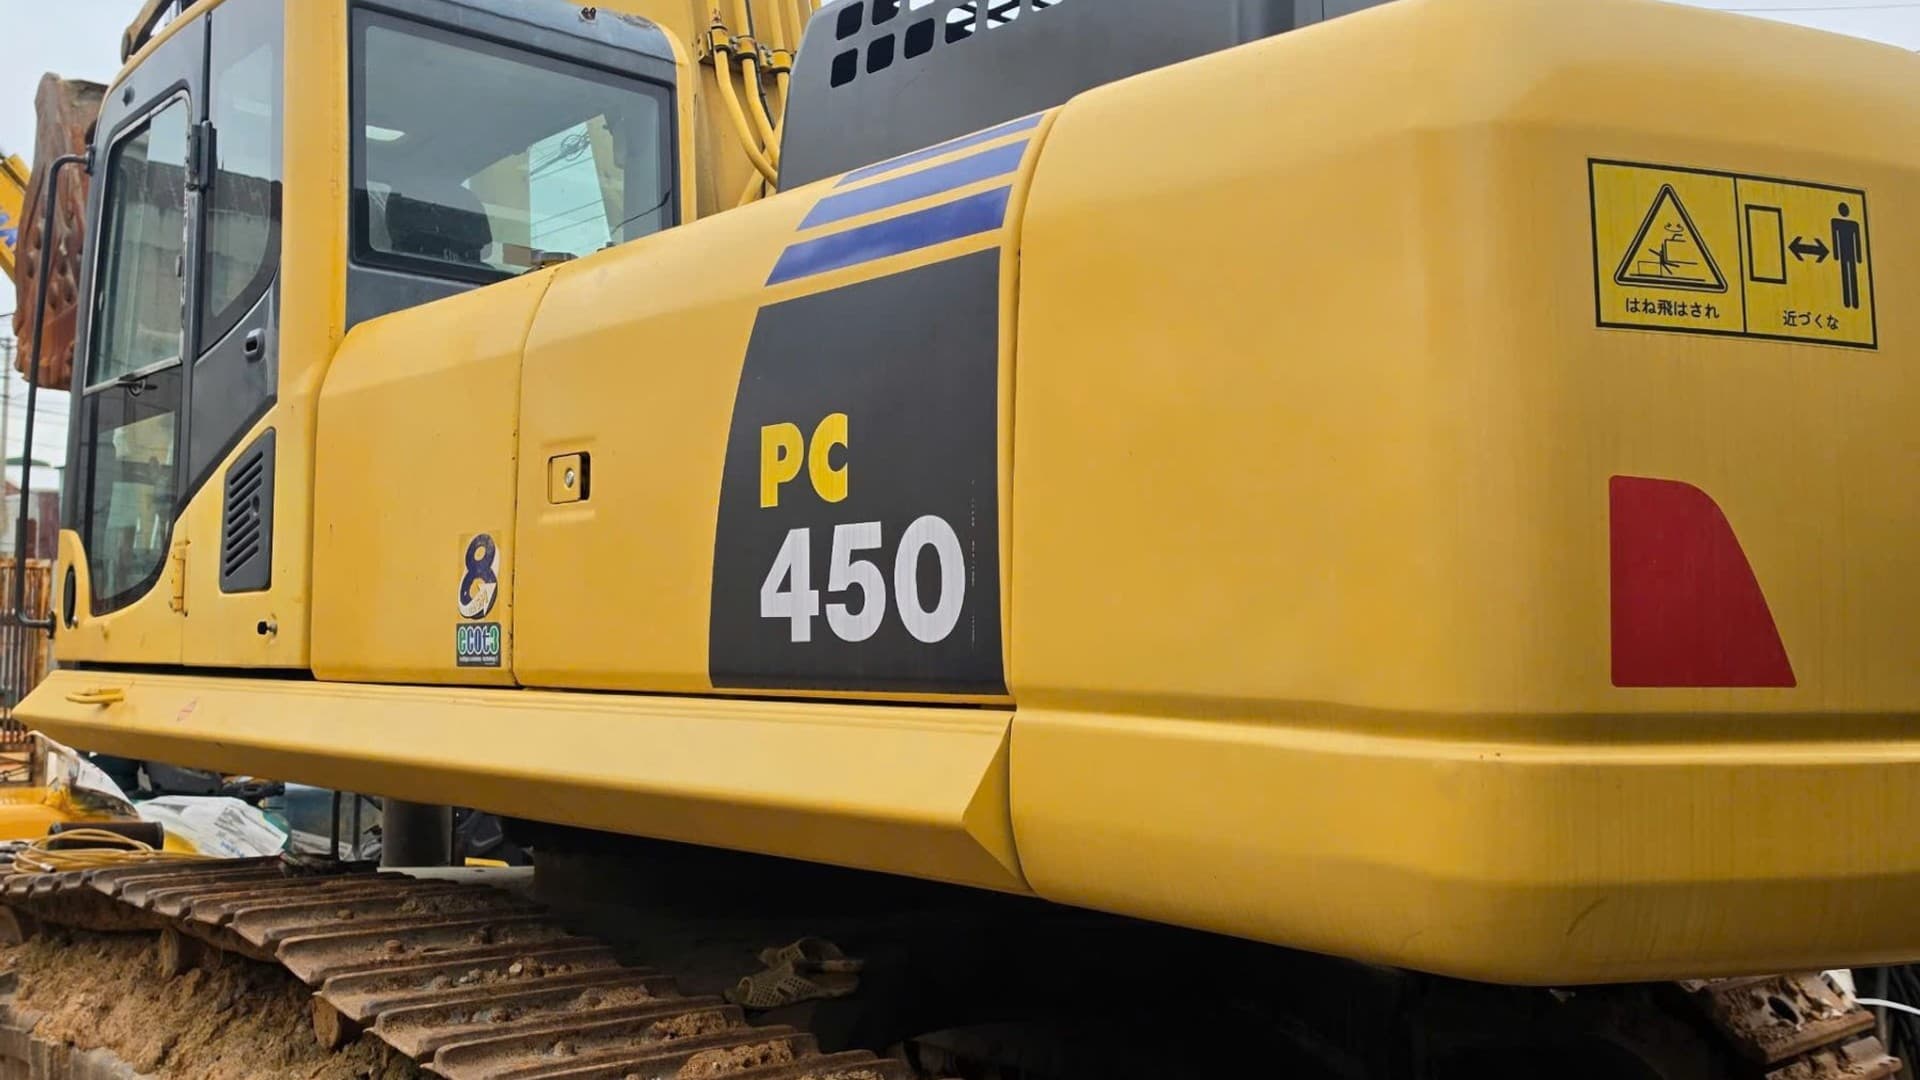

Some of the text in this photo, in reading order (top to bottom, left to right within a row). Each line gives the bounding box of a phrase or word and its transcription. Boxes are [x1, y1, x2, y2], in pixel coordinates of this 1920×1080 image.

[1782, 310, 1839, 330] 近づくな
[760, 412, 848, 508] PC
[459, 533, 498, 620] 8
[760, 514, 966, 643] 450
[458, 625, 500, 655] ecot3
